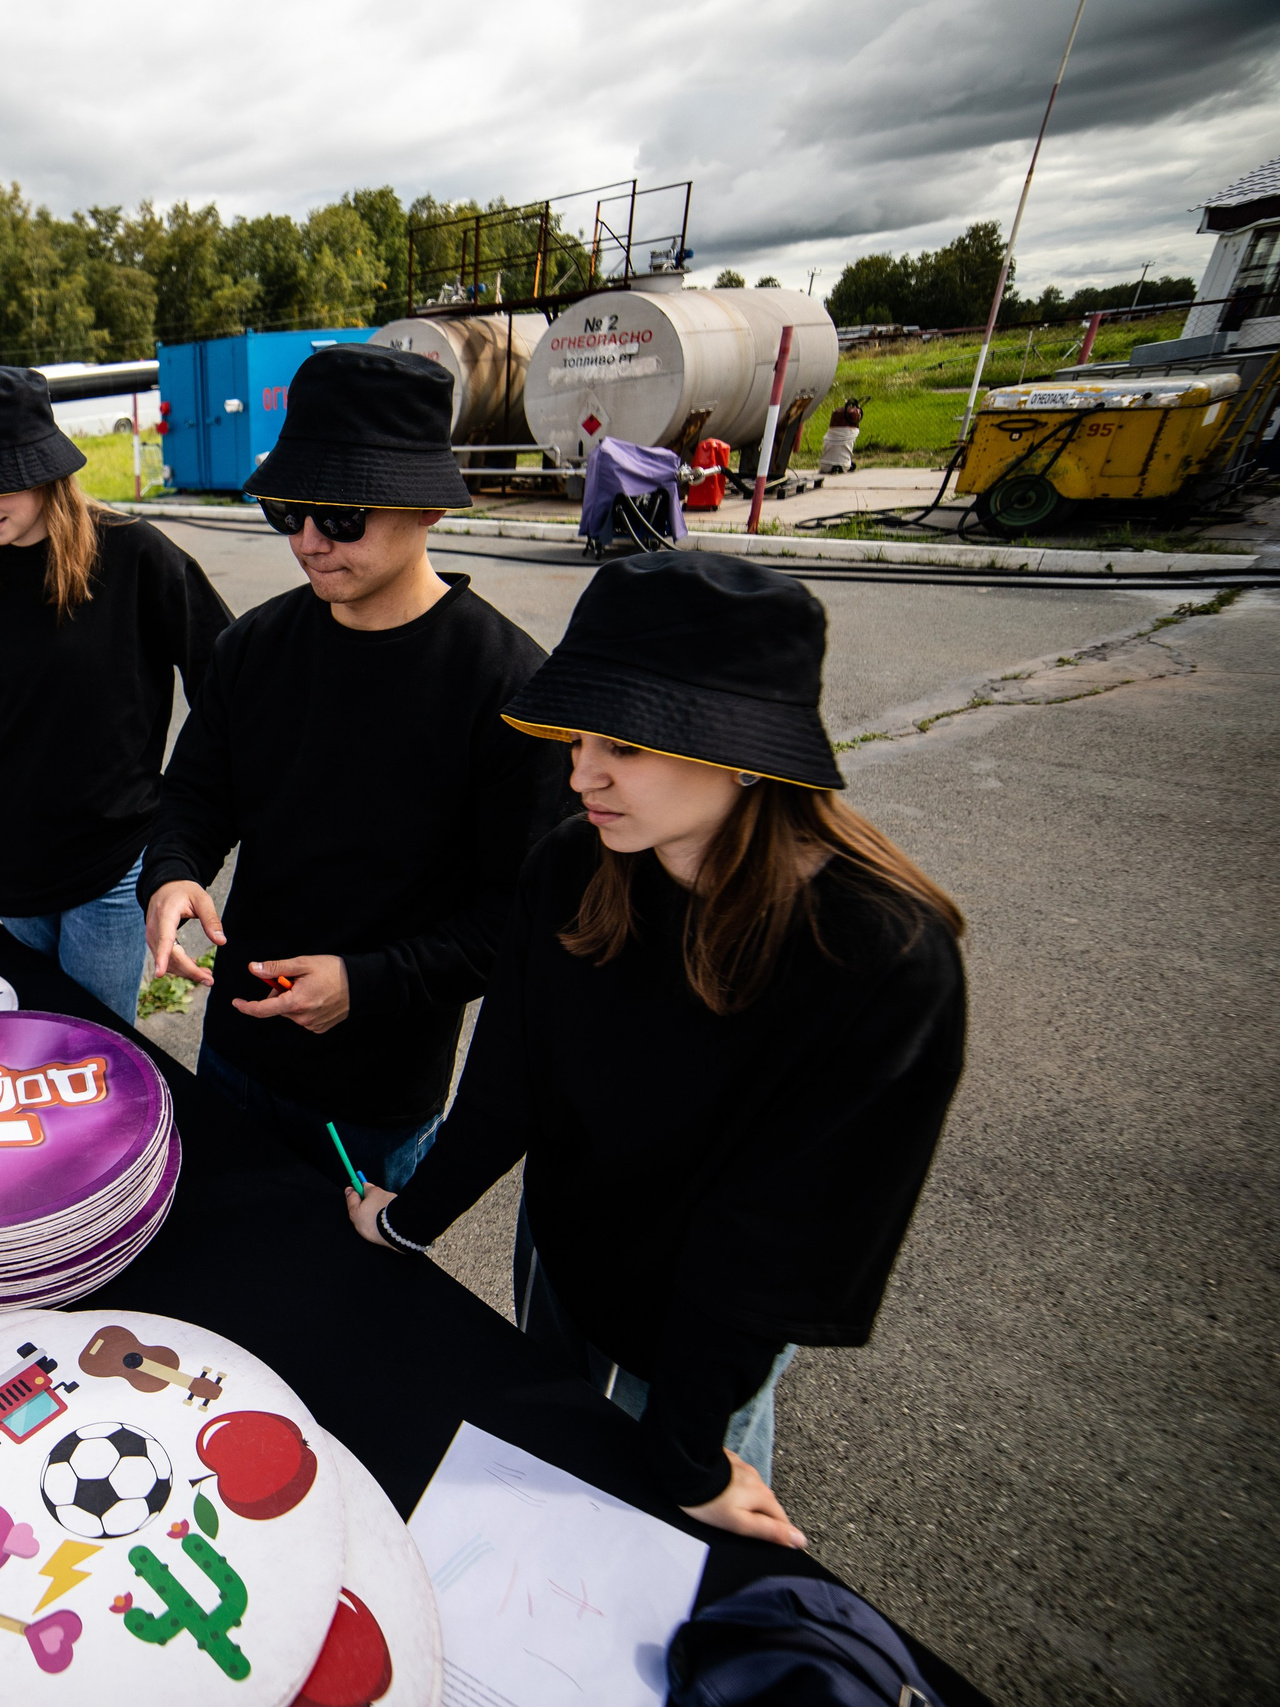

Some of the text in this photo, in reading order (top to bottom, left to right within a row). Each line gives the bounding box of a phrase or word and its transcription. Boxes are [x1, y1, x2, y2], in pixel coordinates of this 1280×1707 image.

[608, 314, 619, 330] 2
[550, 329, 653, 352] ОГНЕОПАСНО
[563, 353, 634, 369] ТОПЛИВО РТ
[1030, 392, 1069, 405] ОГНЕОПАСНО
[1086, 422, 1115, 437] 95
